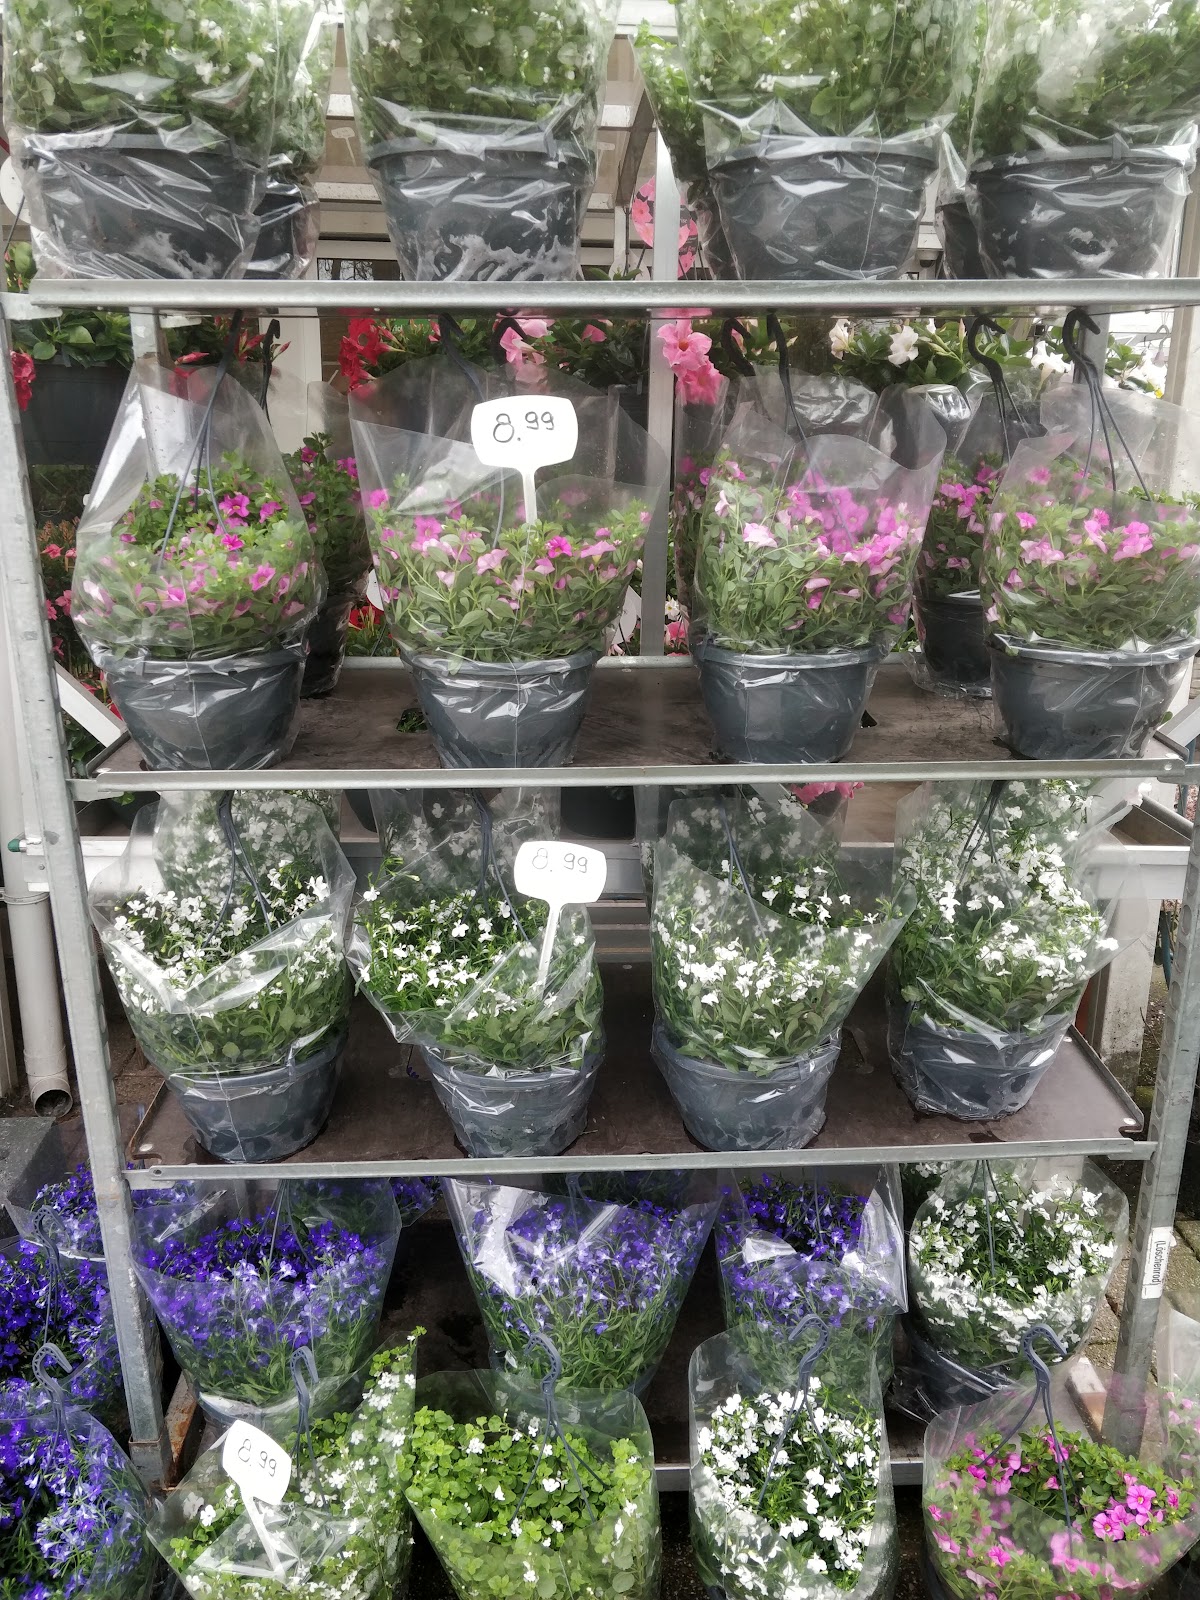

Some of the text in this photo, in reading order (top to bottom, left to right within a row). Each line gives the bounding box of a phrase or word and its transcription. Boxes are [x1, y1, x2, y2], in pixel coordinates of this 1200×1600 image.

[493, 411, 554, 443] 8.99
[532, 848, 588, 873] 8.99
[238, 1438, 277, 1477] 8.99
